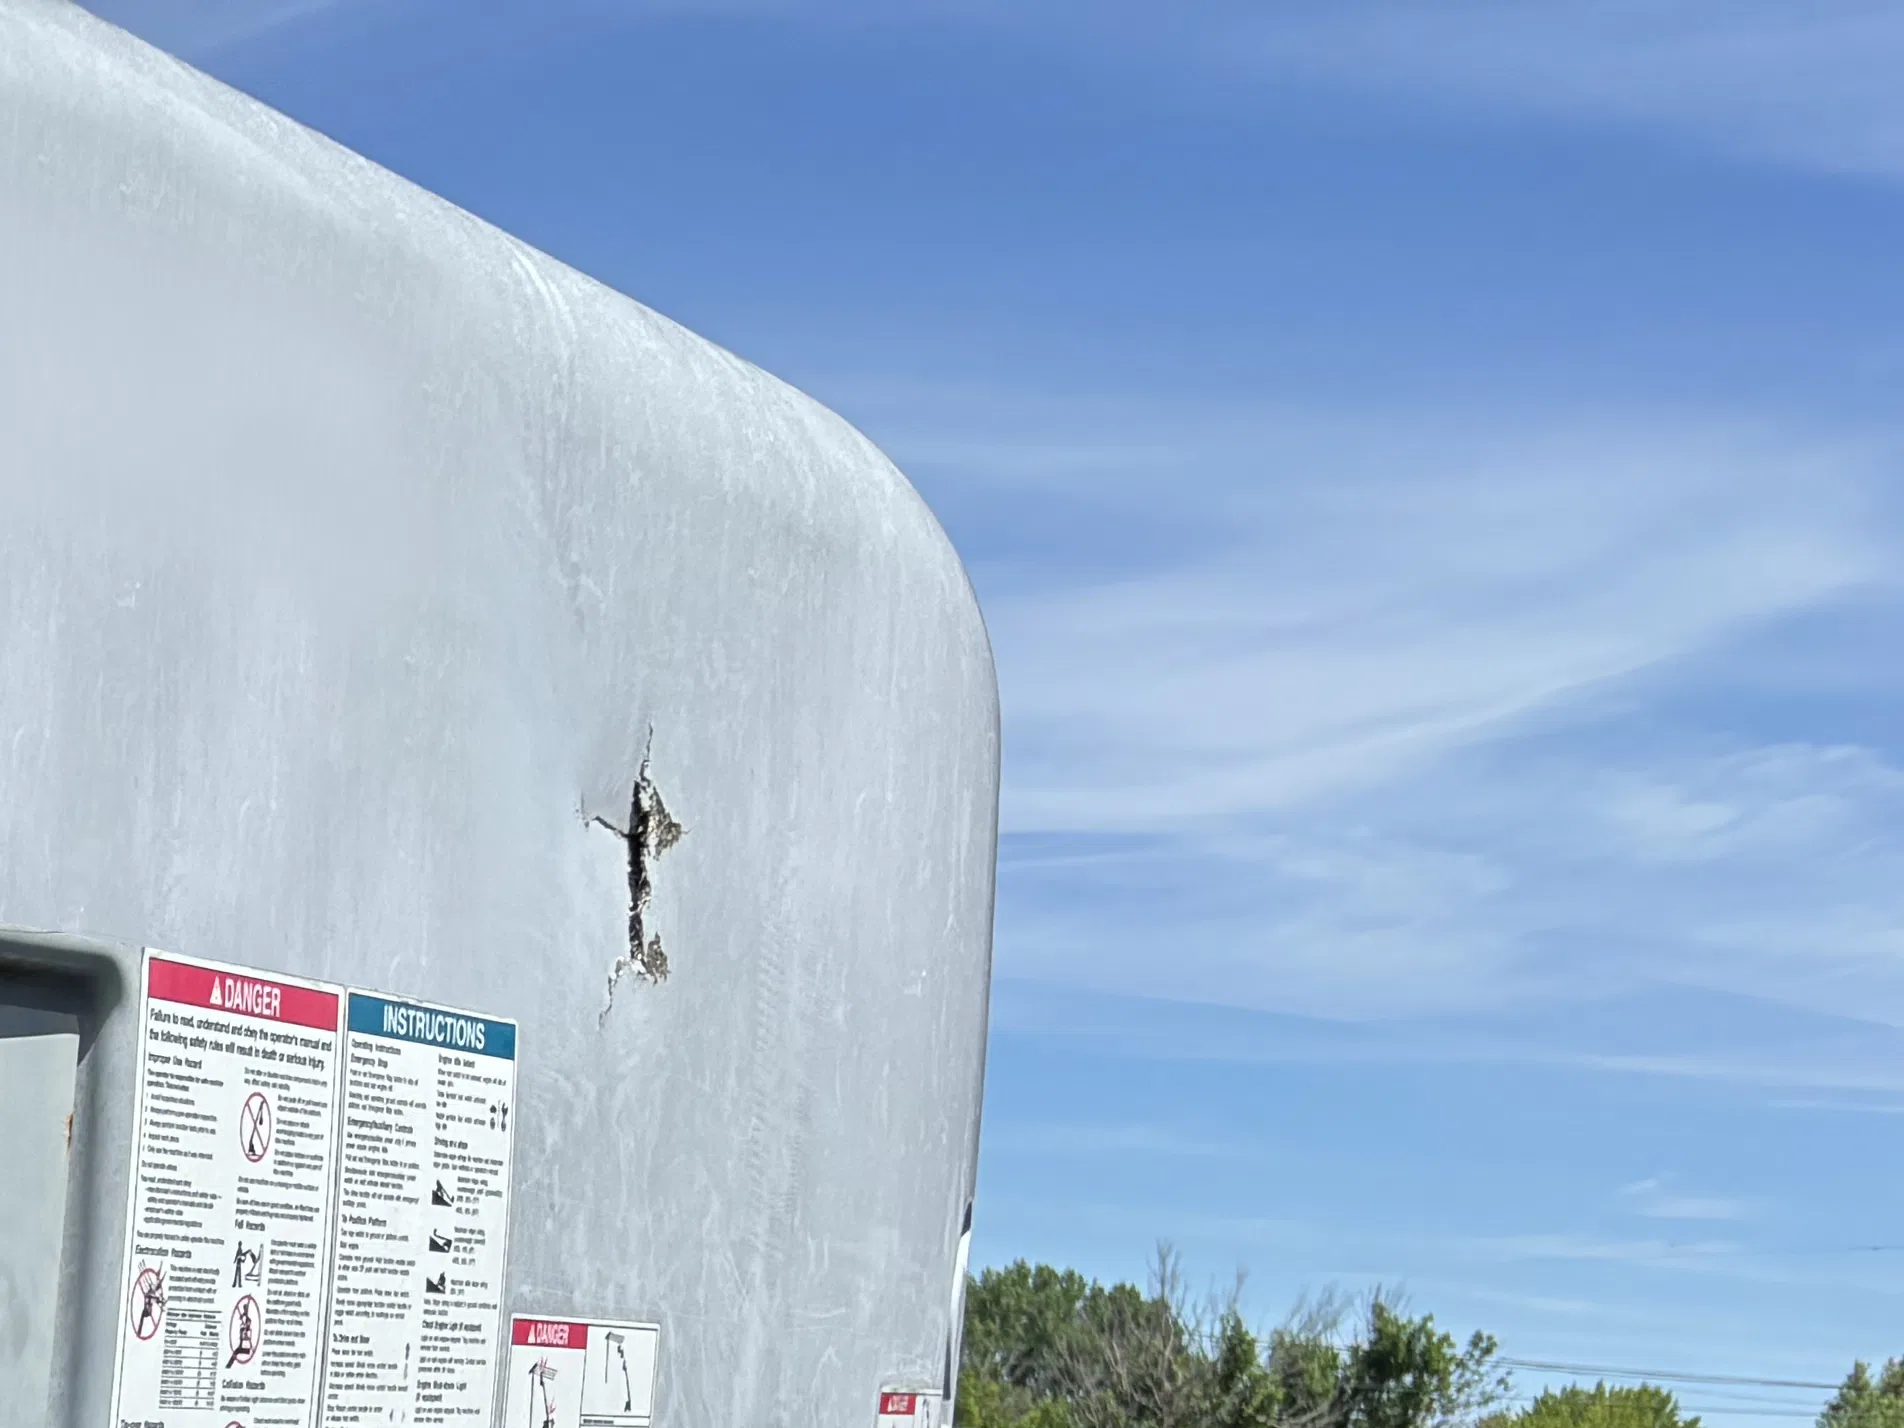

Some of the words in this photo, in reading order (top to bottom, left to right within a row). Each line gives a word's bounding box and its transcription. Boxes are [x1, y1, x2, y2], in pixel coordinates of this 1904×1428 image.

[224, 978, 280, 1017] DANGER
[149, 1007, 171, 1023] Failure
[230, 1024, 243, 1036] and
[383, 1004, 484, 1049] INSTRUCTIONS
[160, 1029, 188, 1049] following
